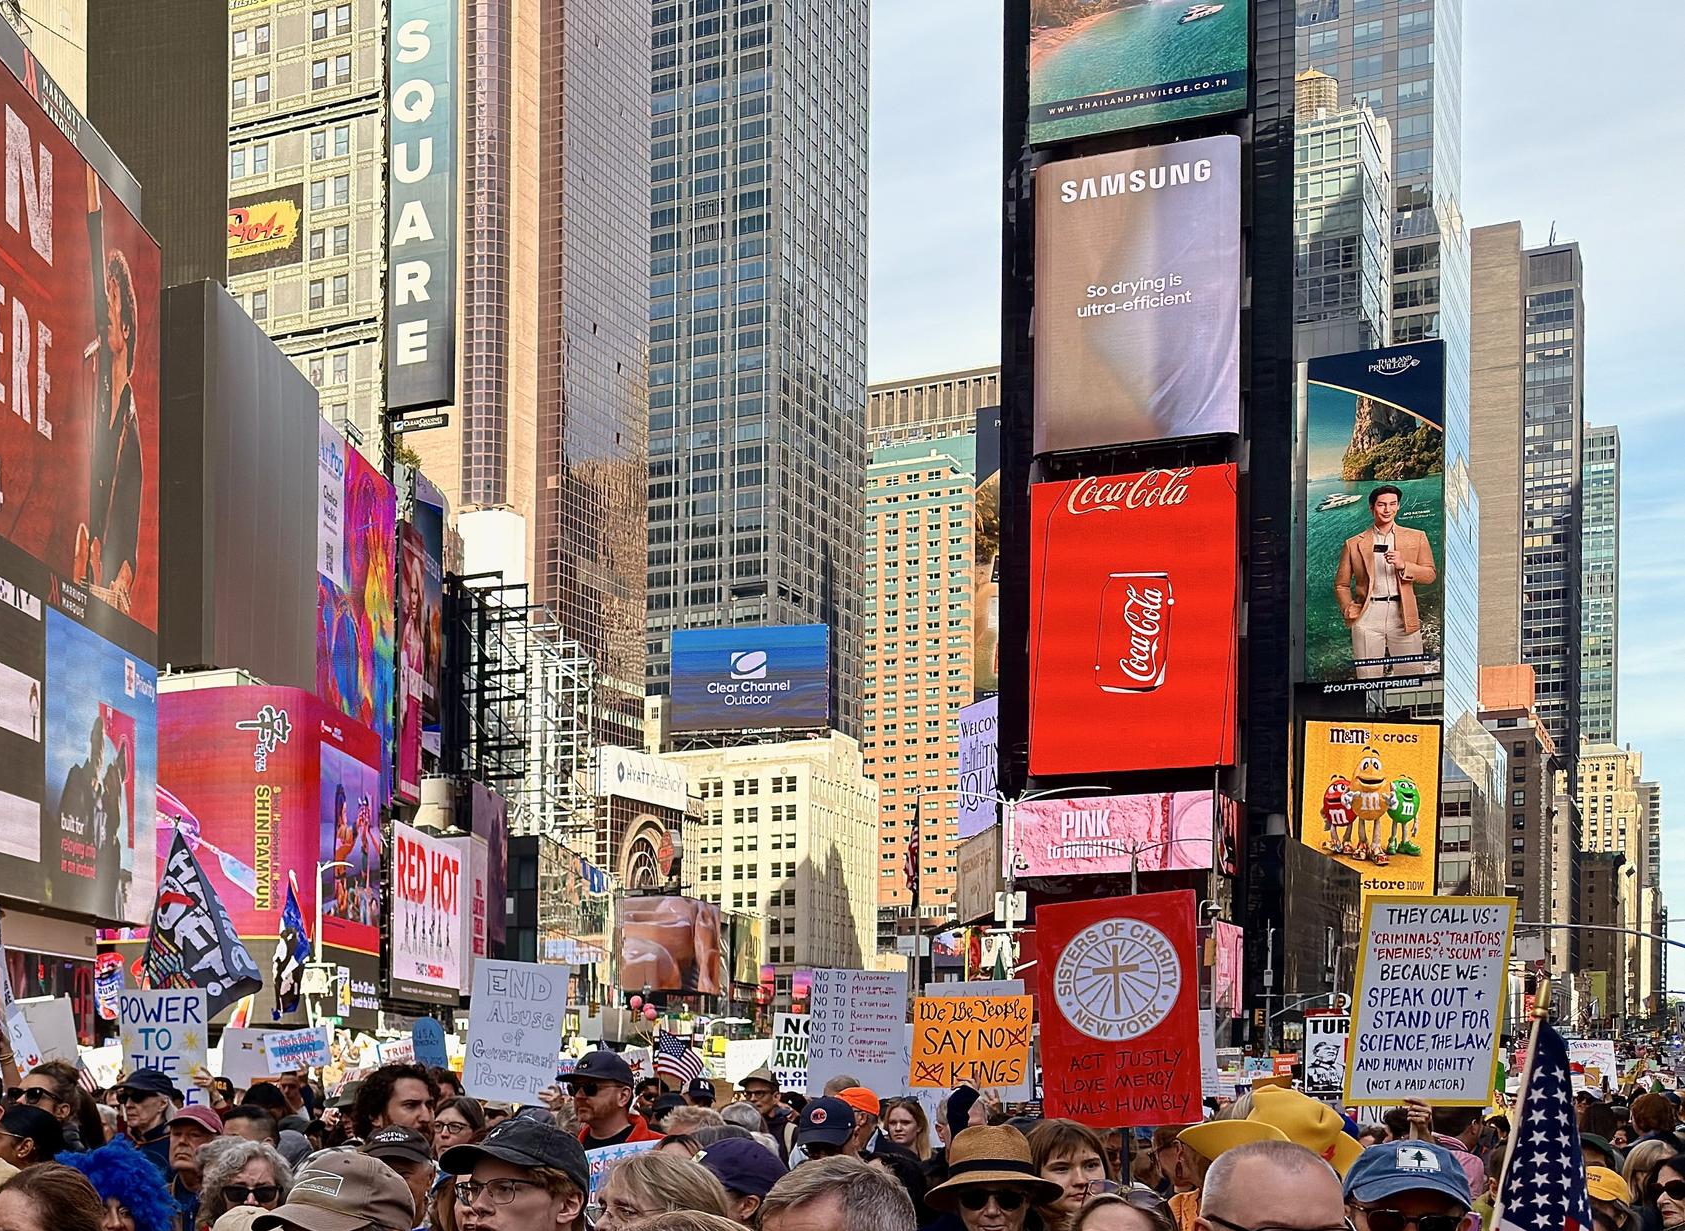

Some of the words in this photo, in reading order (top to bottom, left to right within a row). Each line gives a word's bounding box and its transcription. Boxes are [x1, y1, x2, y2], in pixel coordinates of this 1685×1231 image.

[42, 74, 81, 132] MARRIOTT
[1049, 79, 1228, 115] WWW.THAILANDPRIVILEGE.CO.TH
[391, 19, 436, 367] SQUARE
[1061, 160, 1212, 203] SAMSUNG
[1087, 284, 1108, 298] So
[1110, 277, 1166, 300] drying
[1168, 272, 1182, 288] is
[1077, 289, 1192, 318] ultra-efficient
[62, 581, 88, 605] MARRIOTT
[707, 683, 739, 694] Clear
[741, 680, 790, 692] Channel
[1324, 678, 1421, 693] #OUTFRONTPRIME
[724, 694, 772, 706] Outdoor
[1383, 733, 1418, 743] crocs
[627, 767, 650, 784] HYATT
[651, 773, 681, 792] REGENCY
[256, 786, 270, 831] SHIN
[61, 811, 74, 832] built
[74, 815, 85, 836] for
[1061, 810, 1112, 838] PINK
[1047, 841, 1061, 860] to
[1062, 839, 1125, 859] BRIGHTEN
[256, 835, 270, 909] RAMYUN
[397, 836, 427, 904] RED
[431, 850, 459, 915] HOT
[1406, 881, 1424, 891] now
[1387, 908, 1428, 925] THEY
[1431, 907, 1470, 924] CALL
[1471, 907, 1499, 923] US:
[1058, 930, 1099, 997] SISTERS
[1101, 922, 1125, 937] OF
[1129, 924, 1178, 990] CHARITY
[815, 971, 829, 981] NO
[836, 971, 847, 981] TO
[1380, 963, 1452, 981] BECAUSE
[1456, 963, 1487, 980] WE:
[487, 968, 553, 1001] END
[814, 984, 828, 994] NO
[835, 984, 846, 994] TO
[813, 997, 827, 1006] NO
[834, 997, 845, 1006] TO
[1368, 987, 1425, 1008] SPEAK
[1431, 986, 1466, 1007] OUT
[120, 996, 201, 1027] POWER
[486, 1000, 555, 1031] Abuse
[813, 1010, 826, 1019] NO
[832, 1010, 844, 1019] TO
[919, 1001, 945, 1021] We
[972, 998, 1028, 1023] People
[1072, 1008, 1113, 1037] NEW
[1116, 1004, 1165, 1038] YORK
[1373, 1010, 1431, 1030] STAND
[1434, 1010, 1457, 1028] UP
[1462, 1009, 1490, 1029] FOR
[502, 1030, 525, 1046] of
[811, 1022, 826, 1032] NO
[831, 1022, 843, 1032] TO
[138, 1028, 173, 1051] TO
[810, 1035, 825, 1044] NO
[831, 1035, 843, 1044] TO
[923, 1027, 971, 1055] SAY
[978, 1027, 1004, 1050] NO
[1360, 1033, 1429, 1053] SCIENCE,
[1430, 1033, 1453, 1049] THE
[472, 1038, 556, 1069] Government
[810, 1048, 823, 1058] NO
[829, 1048, 842, 1058] TO
[1070, 1053, 1106, 1072] ACT
[1115, 1050, 1183, 1070] JUSTLY
[1356, 1057, 1380, 1072] AND
[1383, 1056, 1423, 1072] HUMAN
[1427, 1055, 1475, 1072] DIGNITY
[131, 1056, 181, 1080] THE
[474, 1062, 544, 1094] Power
[951, 1058, 1021, 1084] KINGS
[1061, 1077, 1106, 1094] LOVE
[1114, 1071, 1174, 1092] MERCY
[1366, 1077, 1391, 1093] (NOT
[1393, 1078, 1402, 1090] A
[1404, 1078, 1424, 1091] PAID
[1425, 1076, 1465, 1091] ACTOR)
[1065, 1100, 1110, 1116] WALK
[1116, 1092, 1190, 1117] HUMBLY
